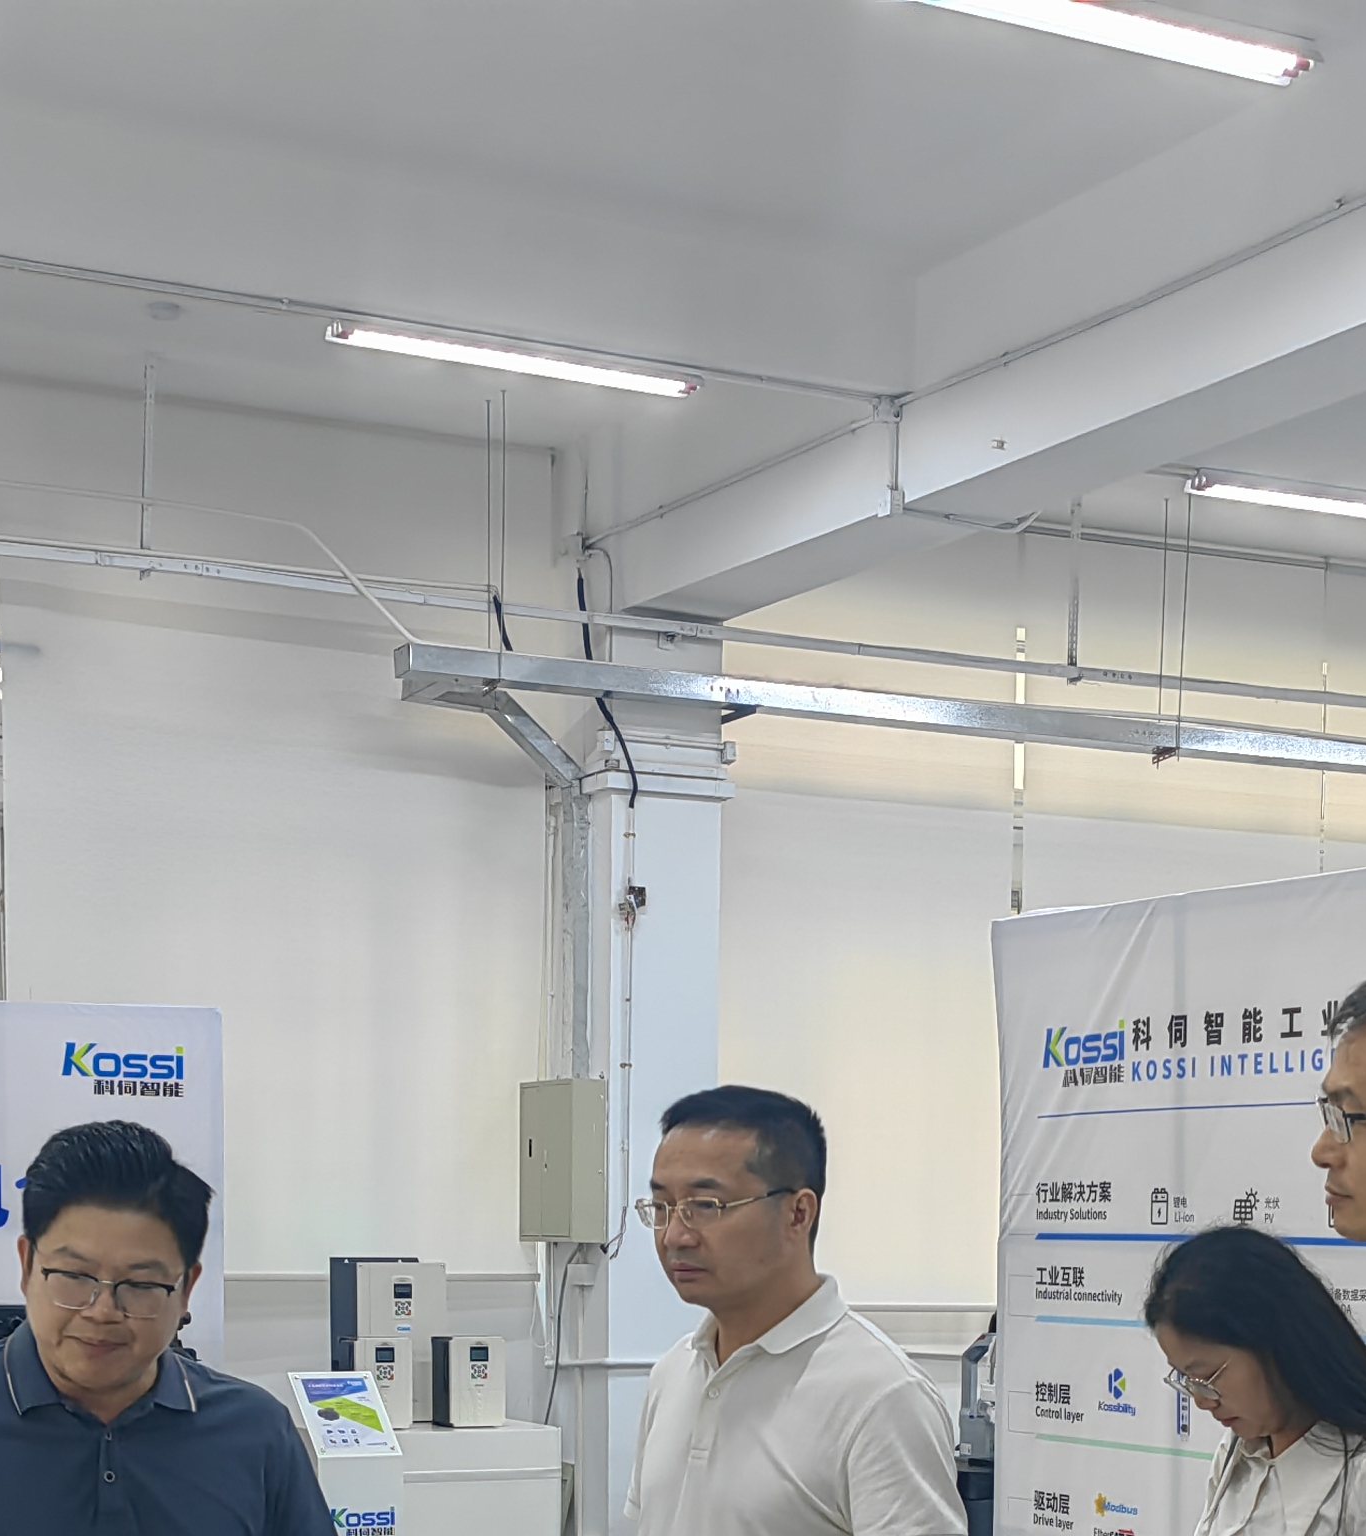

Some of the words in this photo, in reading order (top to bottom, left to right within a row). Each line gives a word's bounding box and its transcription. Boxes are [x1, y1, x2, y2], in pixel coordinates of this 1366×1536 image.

[1042, 1019, 1125, 1069] Kossi
[62, 1041, 184, 1080] Kossi
[1131, 1056, 1197, 1082] KOSSI
[1210, 1047, 1337, 1078] INTELLIG
[1035, 1180, 1113, 1204] 行业解决方案
[1035, 1207, 1069, 1223] Industry
[1069, 1207, 1108, 1222] Solutions
[1264, 1211, 1275, 1224] PV
[1035, 1265, 1085, 1288] 工业互联
[1035, 1287, 1074, 1302] Industrial
[1073, 1289, 1123, 1306] connectivity
[1035, 1381, 1071, 1406] 控制层
[1035, 1405, 1064, 1421] Control
[1064, 1408, 1085, 1424] layer
[1033, 1490, 1070, 1516] 驱动层
[330, 1506, 395, 1528] Kossi
[1033, 1513, 1055, 1528] Drive
[1055, 1515, 1074, 1532] layer
